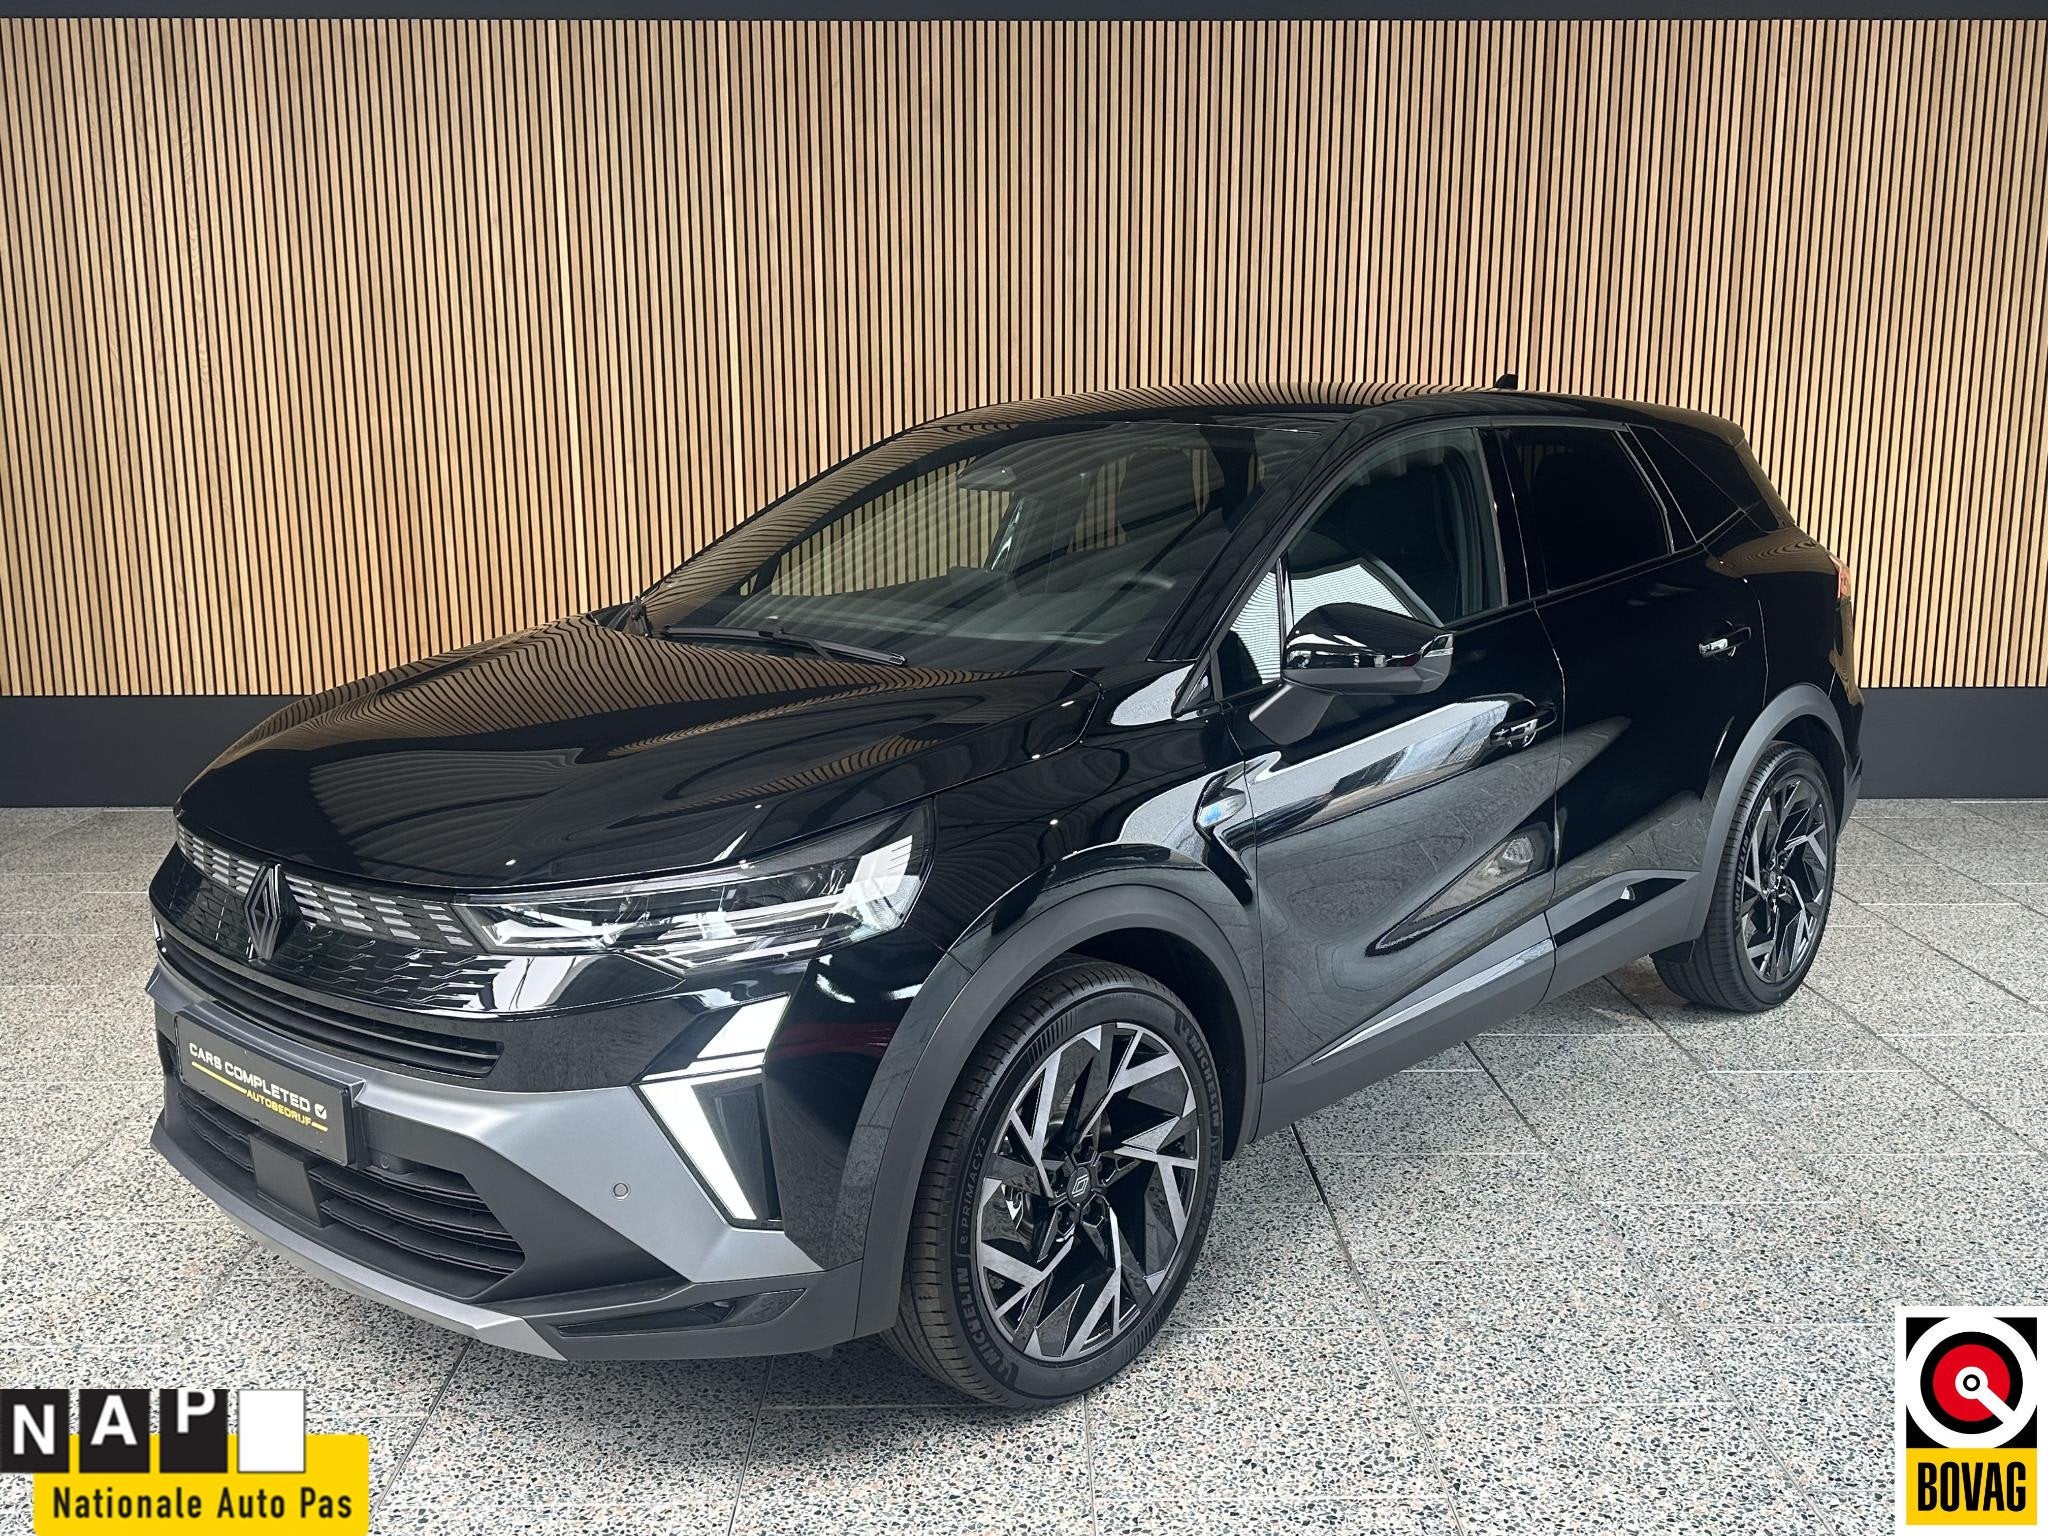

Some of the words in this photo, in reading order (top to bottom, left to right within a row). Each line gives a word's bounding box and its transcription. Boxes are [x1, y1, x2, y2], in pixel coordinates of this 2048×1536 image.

[1735, 834, 1750, 912] MICHELIN
[189, 1042, 222, 1071] CARS
[224, 1061, 311, 1112] COMPLETED
[246, 1089, 313, 1126] AUTOBEDRIJF
[1188, 1035, 1220, 1127] MICHELIN
[956, 1266, 1002, 1367] MICHELIN
